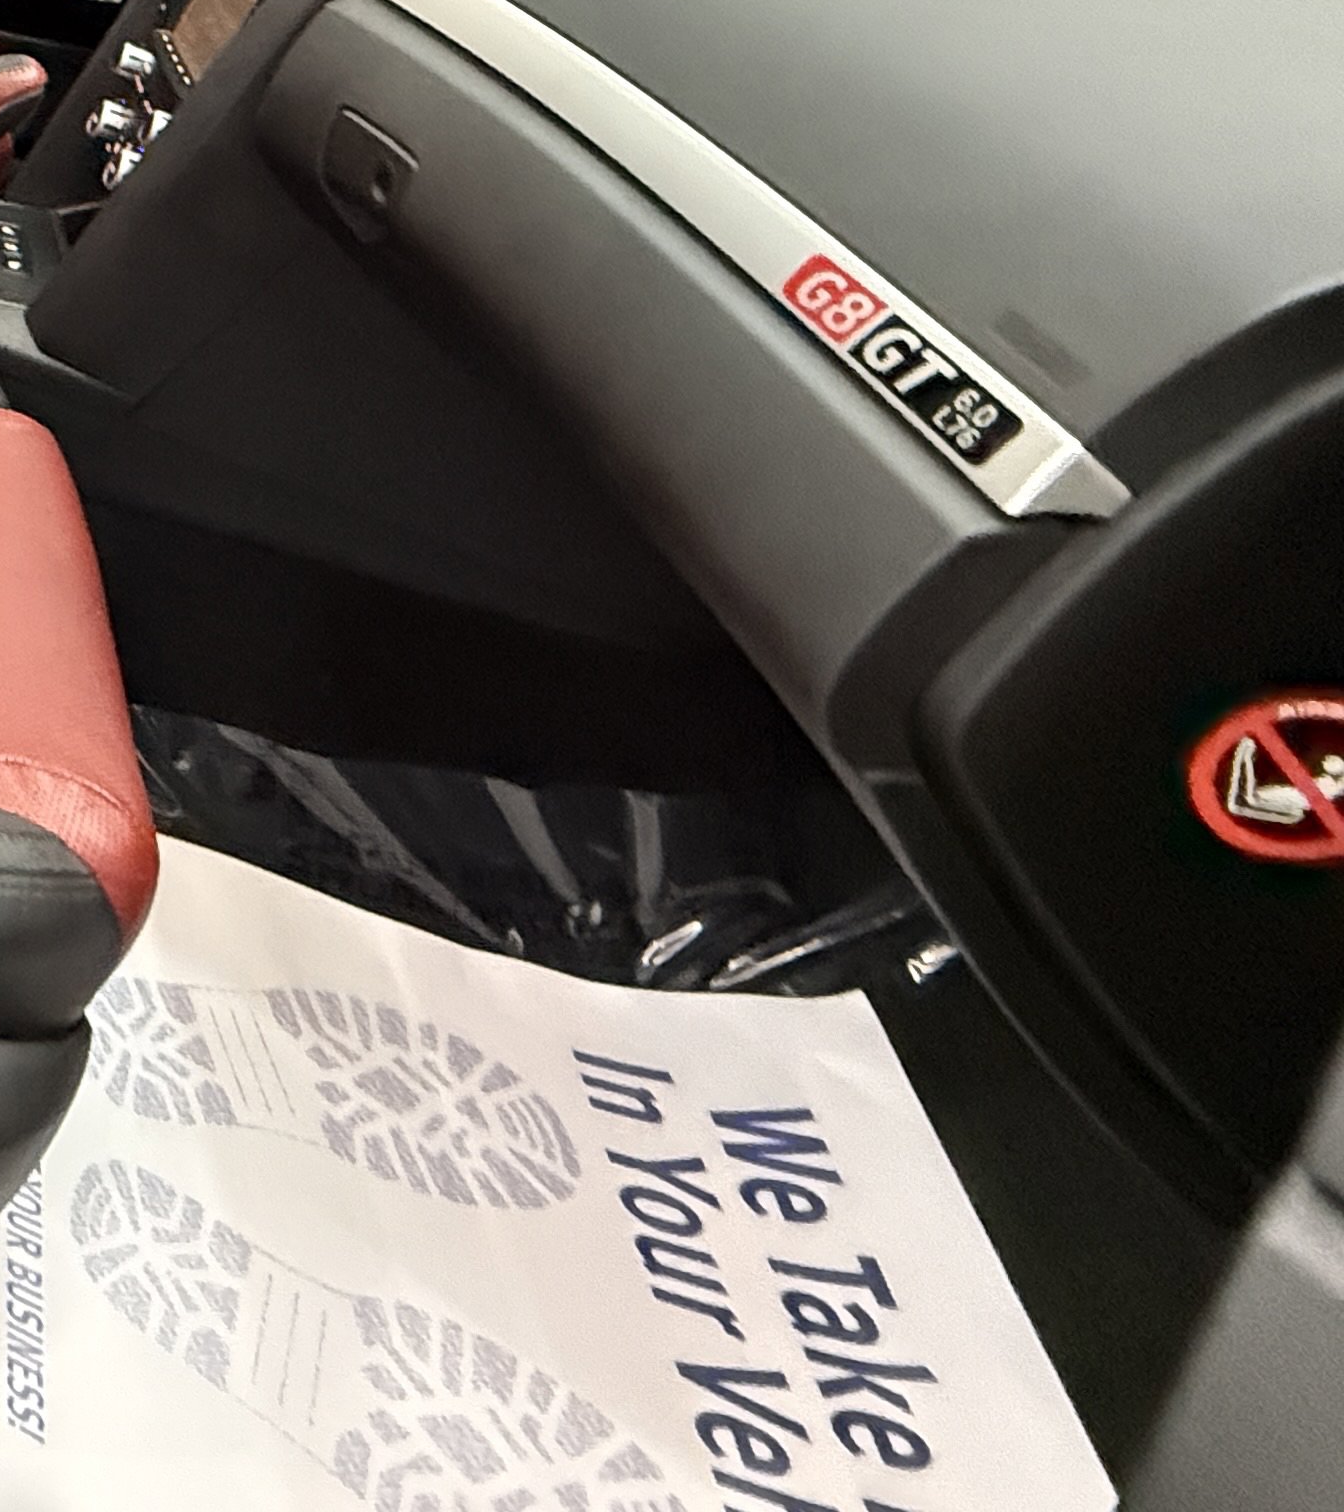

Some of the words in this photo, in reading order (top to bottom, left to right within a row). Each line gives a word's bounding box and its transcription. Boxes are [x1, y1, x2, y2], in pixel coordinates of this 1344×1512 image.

[794, 271, 875, 335] G8
[861, 326, 958, 396] GT
[571, 1048, 675, 1125] In
[710, 1108, 844, 1223] We
[605, 1147, 747, 1343] Your
[6, 1256, 46, 1446] BUSINESS!
[767, 1254, 939, 1471] Take
